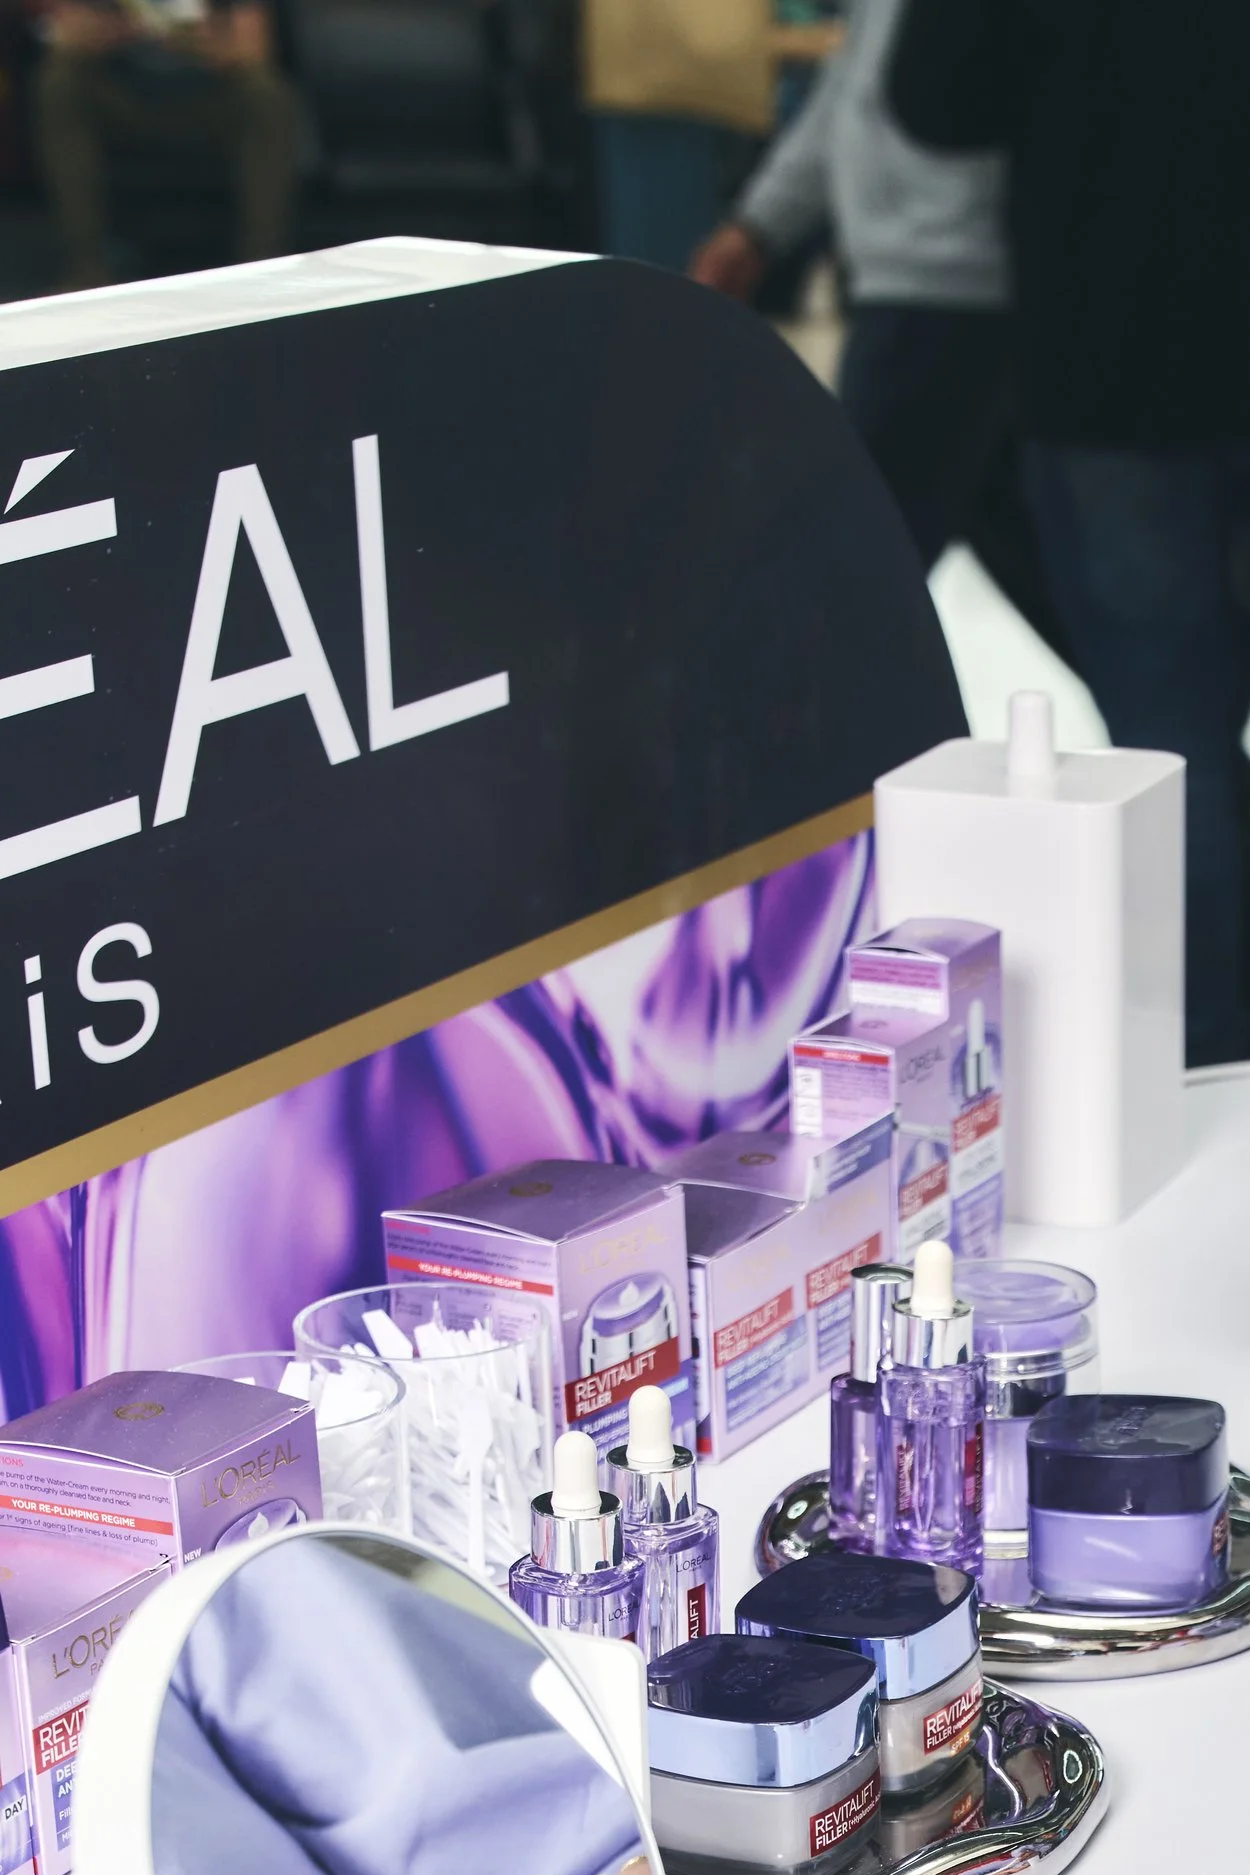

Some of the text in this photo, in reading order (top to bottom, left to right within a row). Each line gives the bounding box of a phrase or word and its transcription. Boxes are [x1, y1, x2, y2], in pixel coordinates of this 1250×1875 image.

[574, 1350, 656, 1402] REVITALIFT
[575, 1391, 612, 1417] FILLER
[0, 1456, 24, 1468] IONS
[201, 1439, 302, 1508] L'ORÉAL
[6, 1471, 24, 1481] pump
[34, 1475, 45, 1483] the
[46, 1477, 89, 1491] Water-Cream
[90, 1486, 108, 1495] every
[109, 1488, 137, 1500] morning
[25, 1483, 58, 1496] thoroughly
[60, 1489, 86, 1500] cleansed
[11, 1499, 136, 1527] YOUR RE-PLUMPING REGIME
[184, 1547, 202, 1563] NEW
[51, 1609, 133, 1679] L'ORÉ
[927, 1679, 982, 1737] REVITALIFT
[927, 1726, 952, 1748] FILLER
[952, 1732, 970, 1751] SPF 15
[4, 1798, 24, 1820] DAY
[815, 1780, 874, 1836] REVITALIFT
[816, 1822, 848, 1849] FILLER
